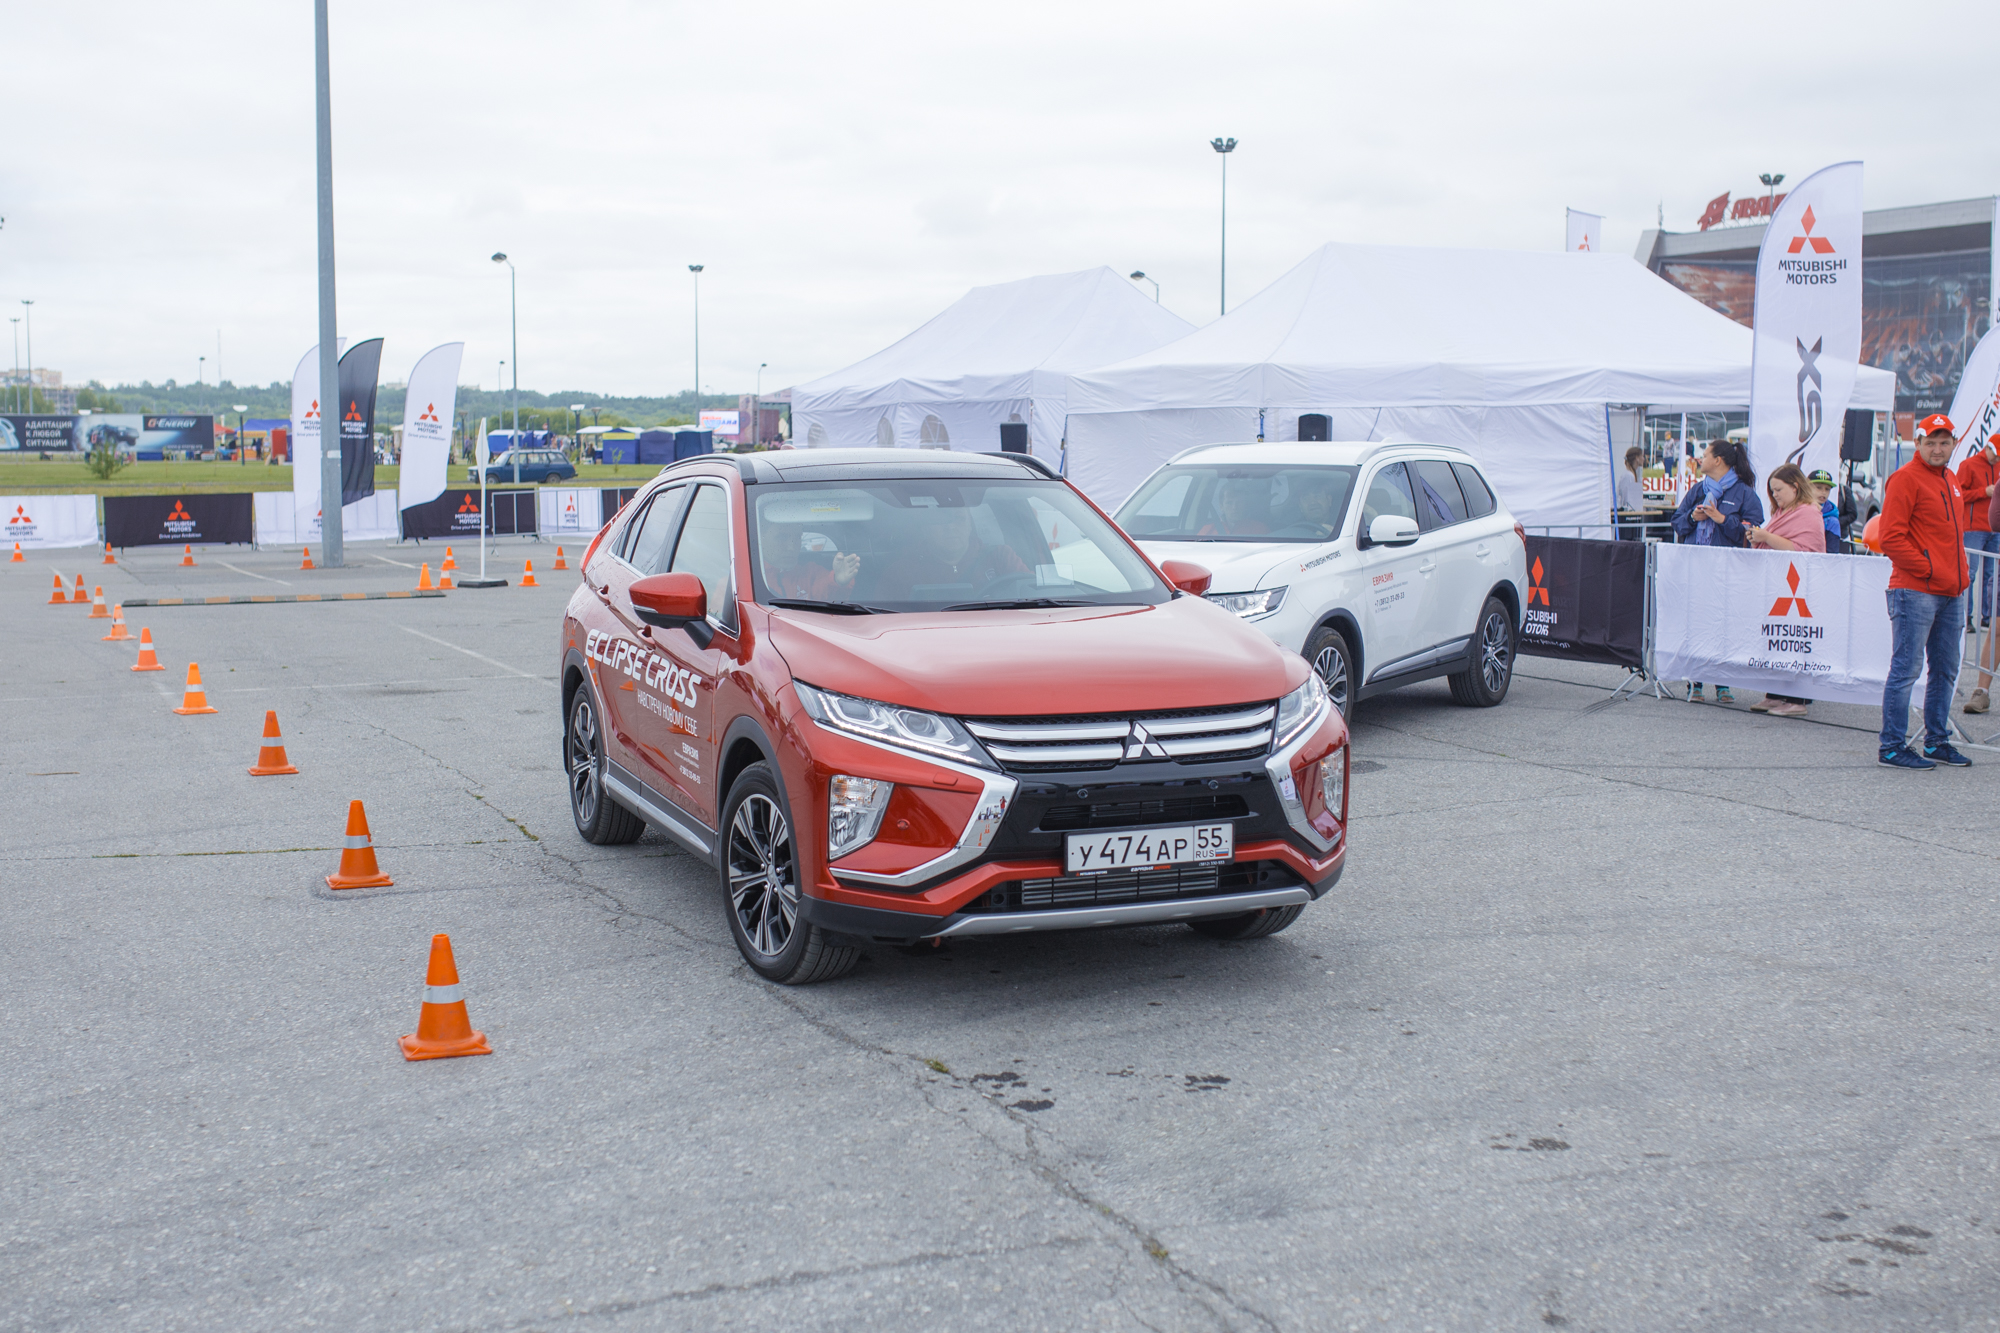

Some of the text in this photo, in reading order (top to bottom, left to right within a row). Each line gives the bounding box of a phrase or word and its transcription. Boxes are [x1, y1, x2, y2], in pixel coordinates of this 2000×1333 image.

[1778, 259, 1847, 271] MITSUBISHI
[1786, 273, 1837, 285] MOTORS
[25, 421, 72, 429] АДАПТАЦИЯ
[414, 421, 442, 429] MITSUBISHI
[32, 429, 61, 438] ЛЮБОЙ
[26, 439, 67, 447] СИТУАЦИИ
[1305, 550, 1341, 570] MITSUBISHI MOTORS
[1372, 571, 1394, 586] ЕВРАЗИЯ
[1528, 610, 1557, 624] SUBISHI
[1525, 623, 1549, 636] OTORS
[1761, 624, 1823, 639] MITSUBISHI
[1768, 640, 1812, 653] MOTORS
[585, 628, 702, 708] ECLIPSE CROSS
[1748, 657, 1769, 668] Drive
[1771, 660, 1790, 670] your
[637, 688, 697, 737] НАВСТРЕЧУ НОВОМУ СЕБЕ
[682, 742, 699, 760] ЕВРАЗИЯ
[1197, 827, 1222, 849] 55
[1196, 850, 1214, 858] RUS
